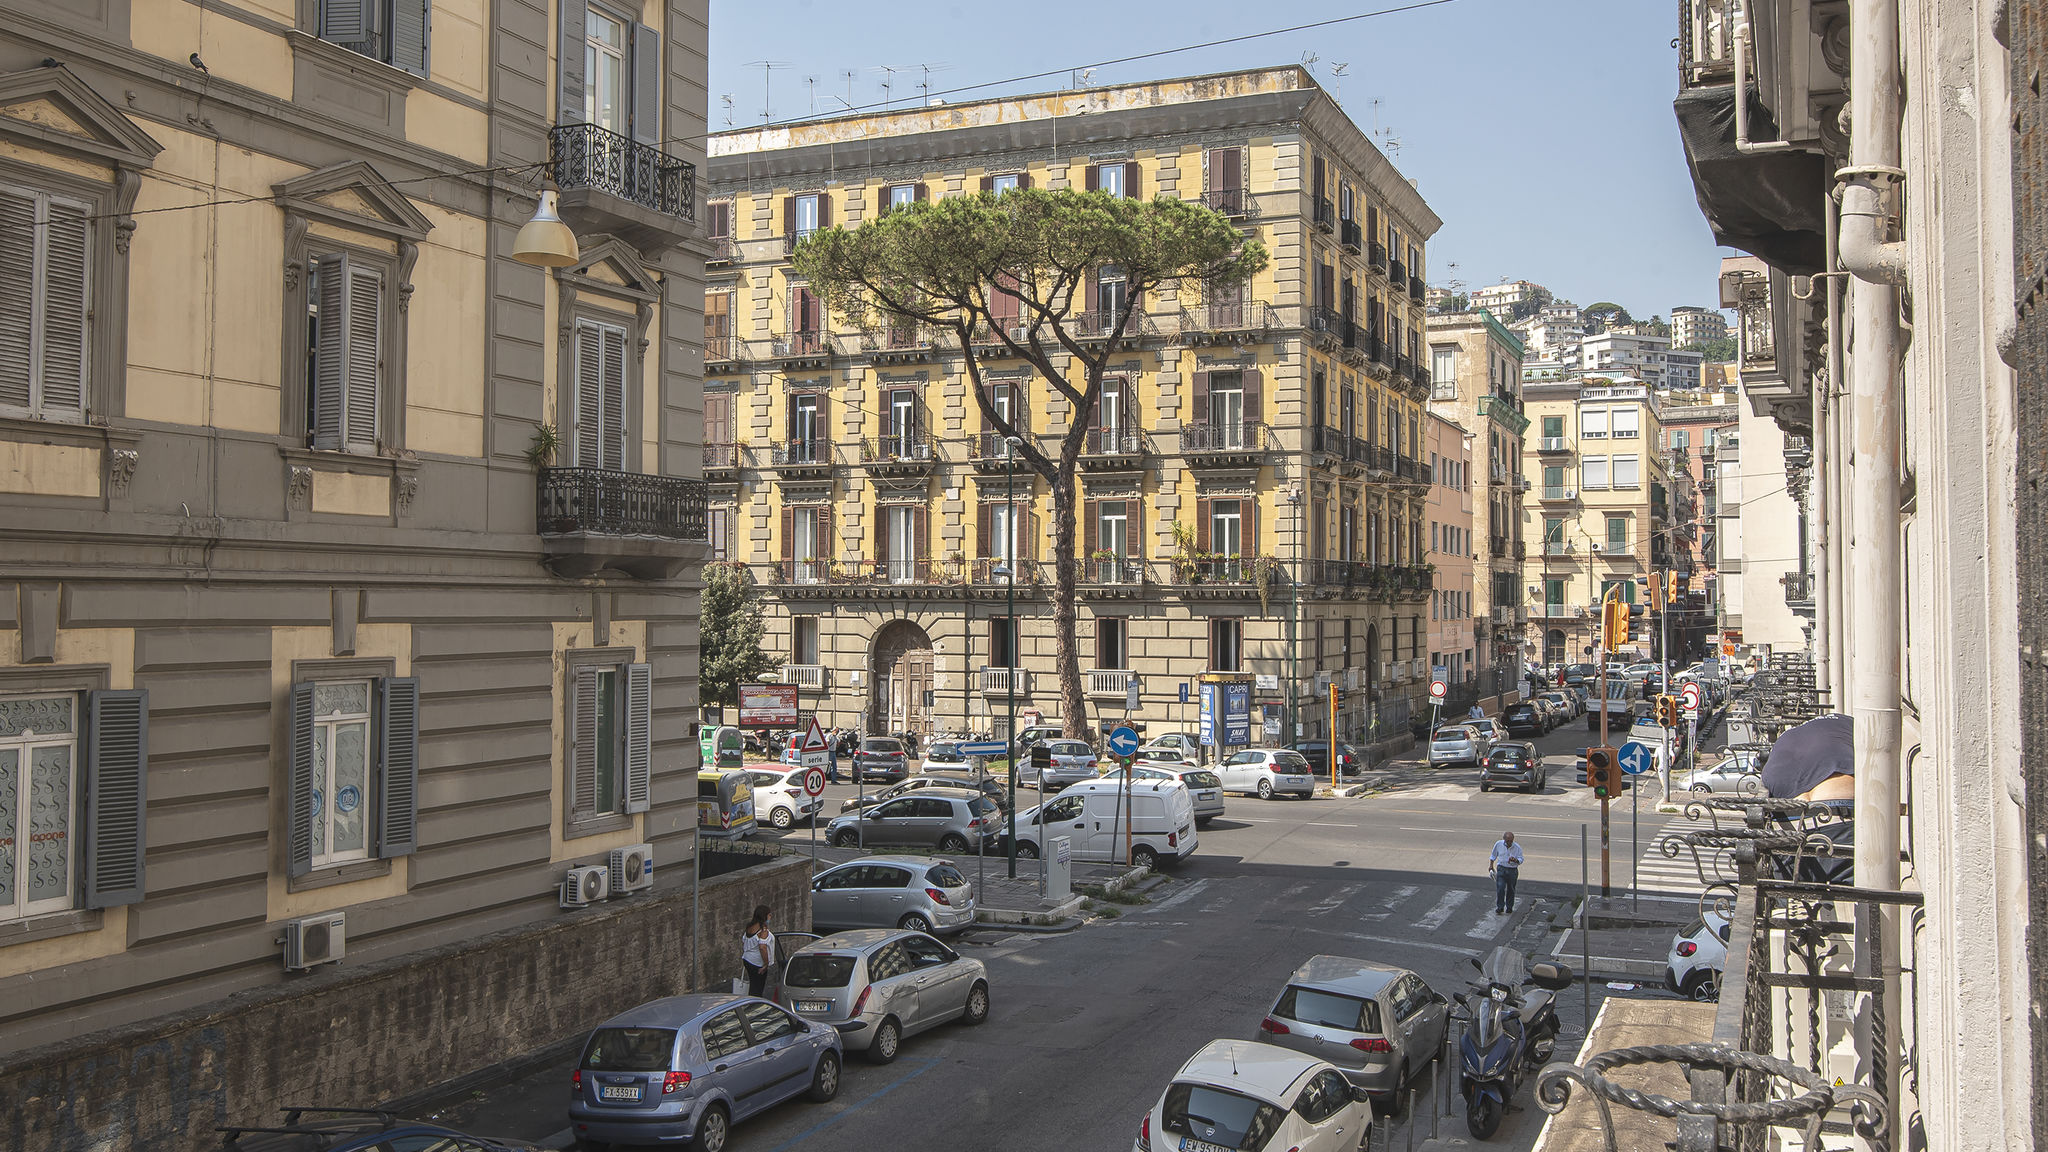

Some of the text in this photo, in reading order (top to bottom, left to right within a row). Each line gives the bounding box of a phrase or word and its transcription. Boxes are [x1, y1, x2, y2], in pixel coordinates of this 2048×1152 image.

[1229, 684, 1248, 694] CAPRI
[808, 755, 823, 764] serie
[809, 775, 822, 789] 20
